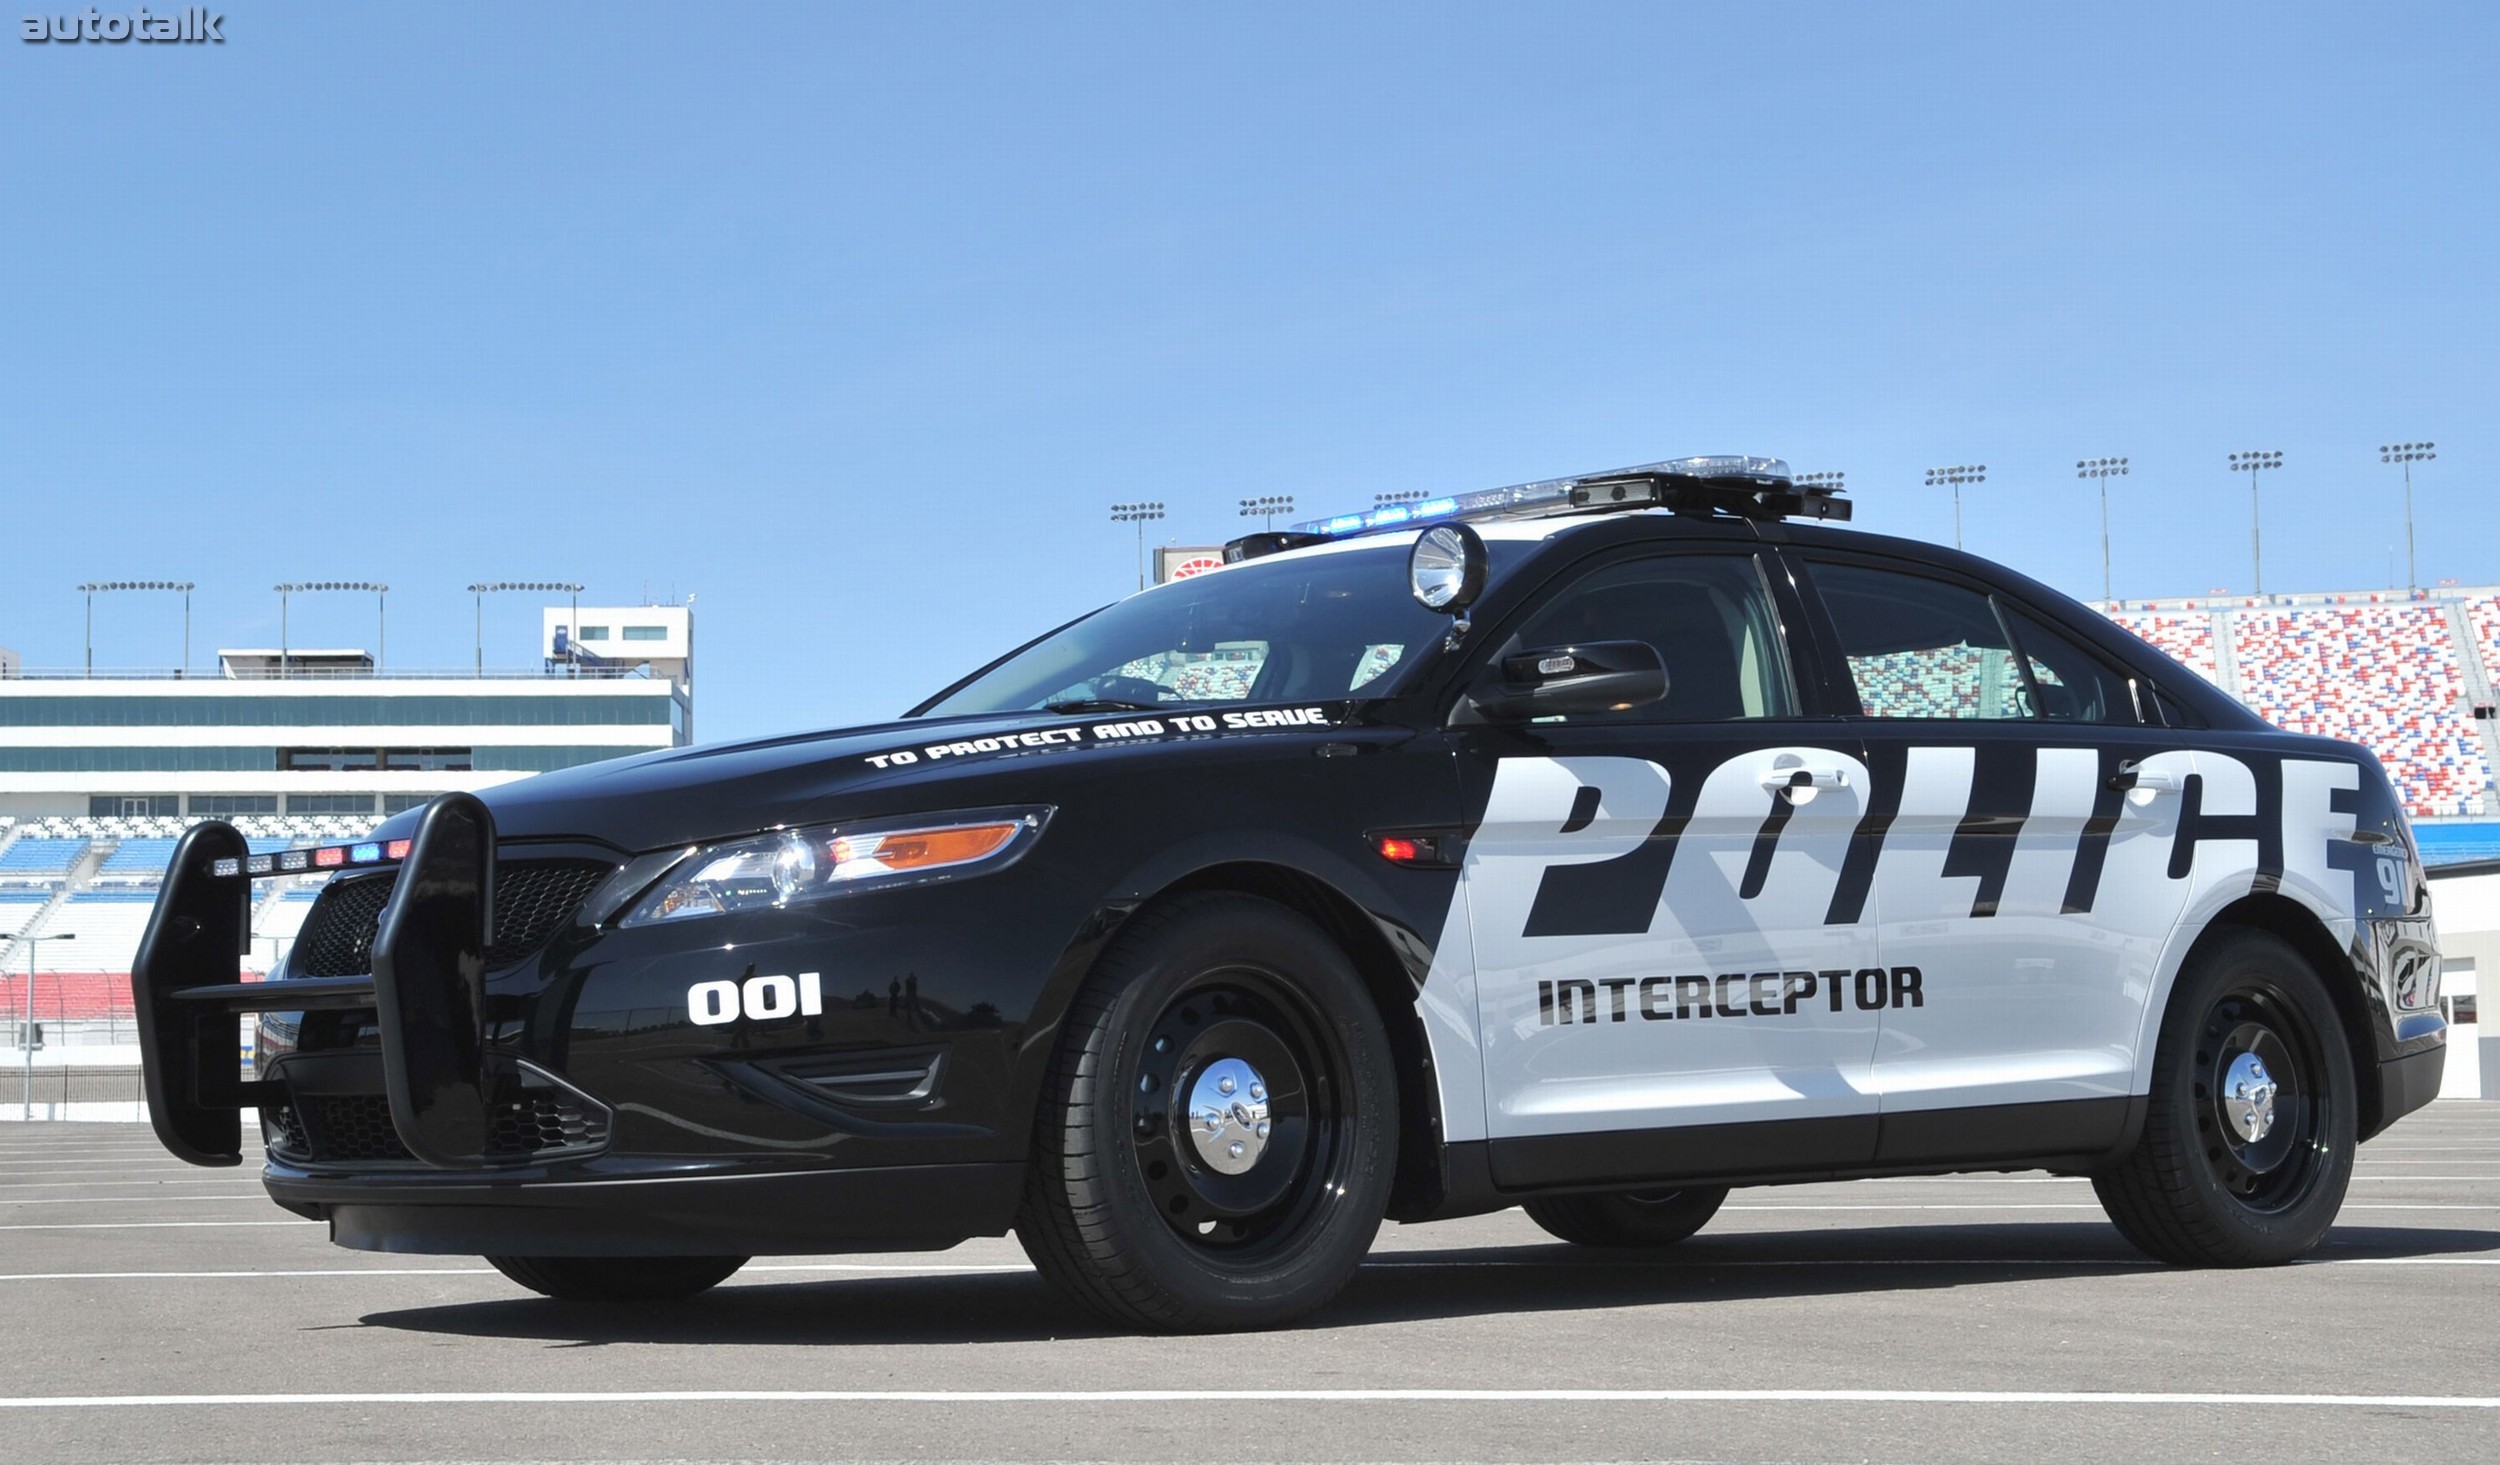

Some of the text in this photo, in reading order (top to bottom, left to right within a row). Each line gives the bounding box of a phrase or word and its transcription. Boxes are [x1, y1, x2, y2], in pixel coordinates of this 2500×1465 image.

[865, 708, 1327, 768] TO PROTECT AND TO SERVE
[1450, 747, 2360, 936] POLICE
[687, 972, 822, 1026] 001
[1538, 966, 1924, 1025] INTERCEPTOR
